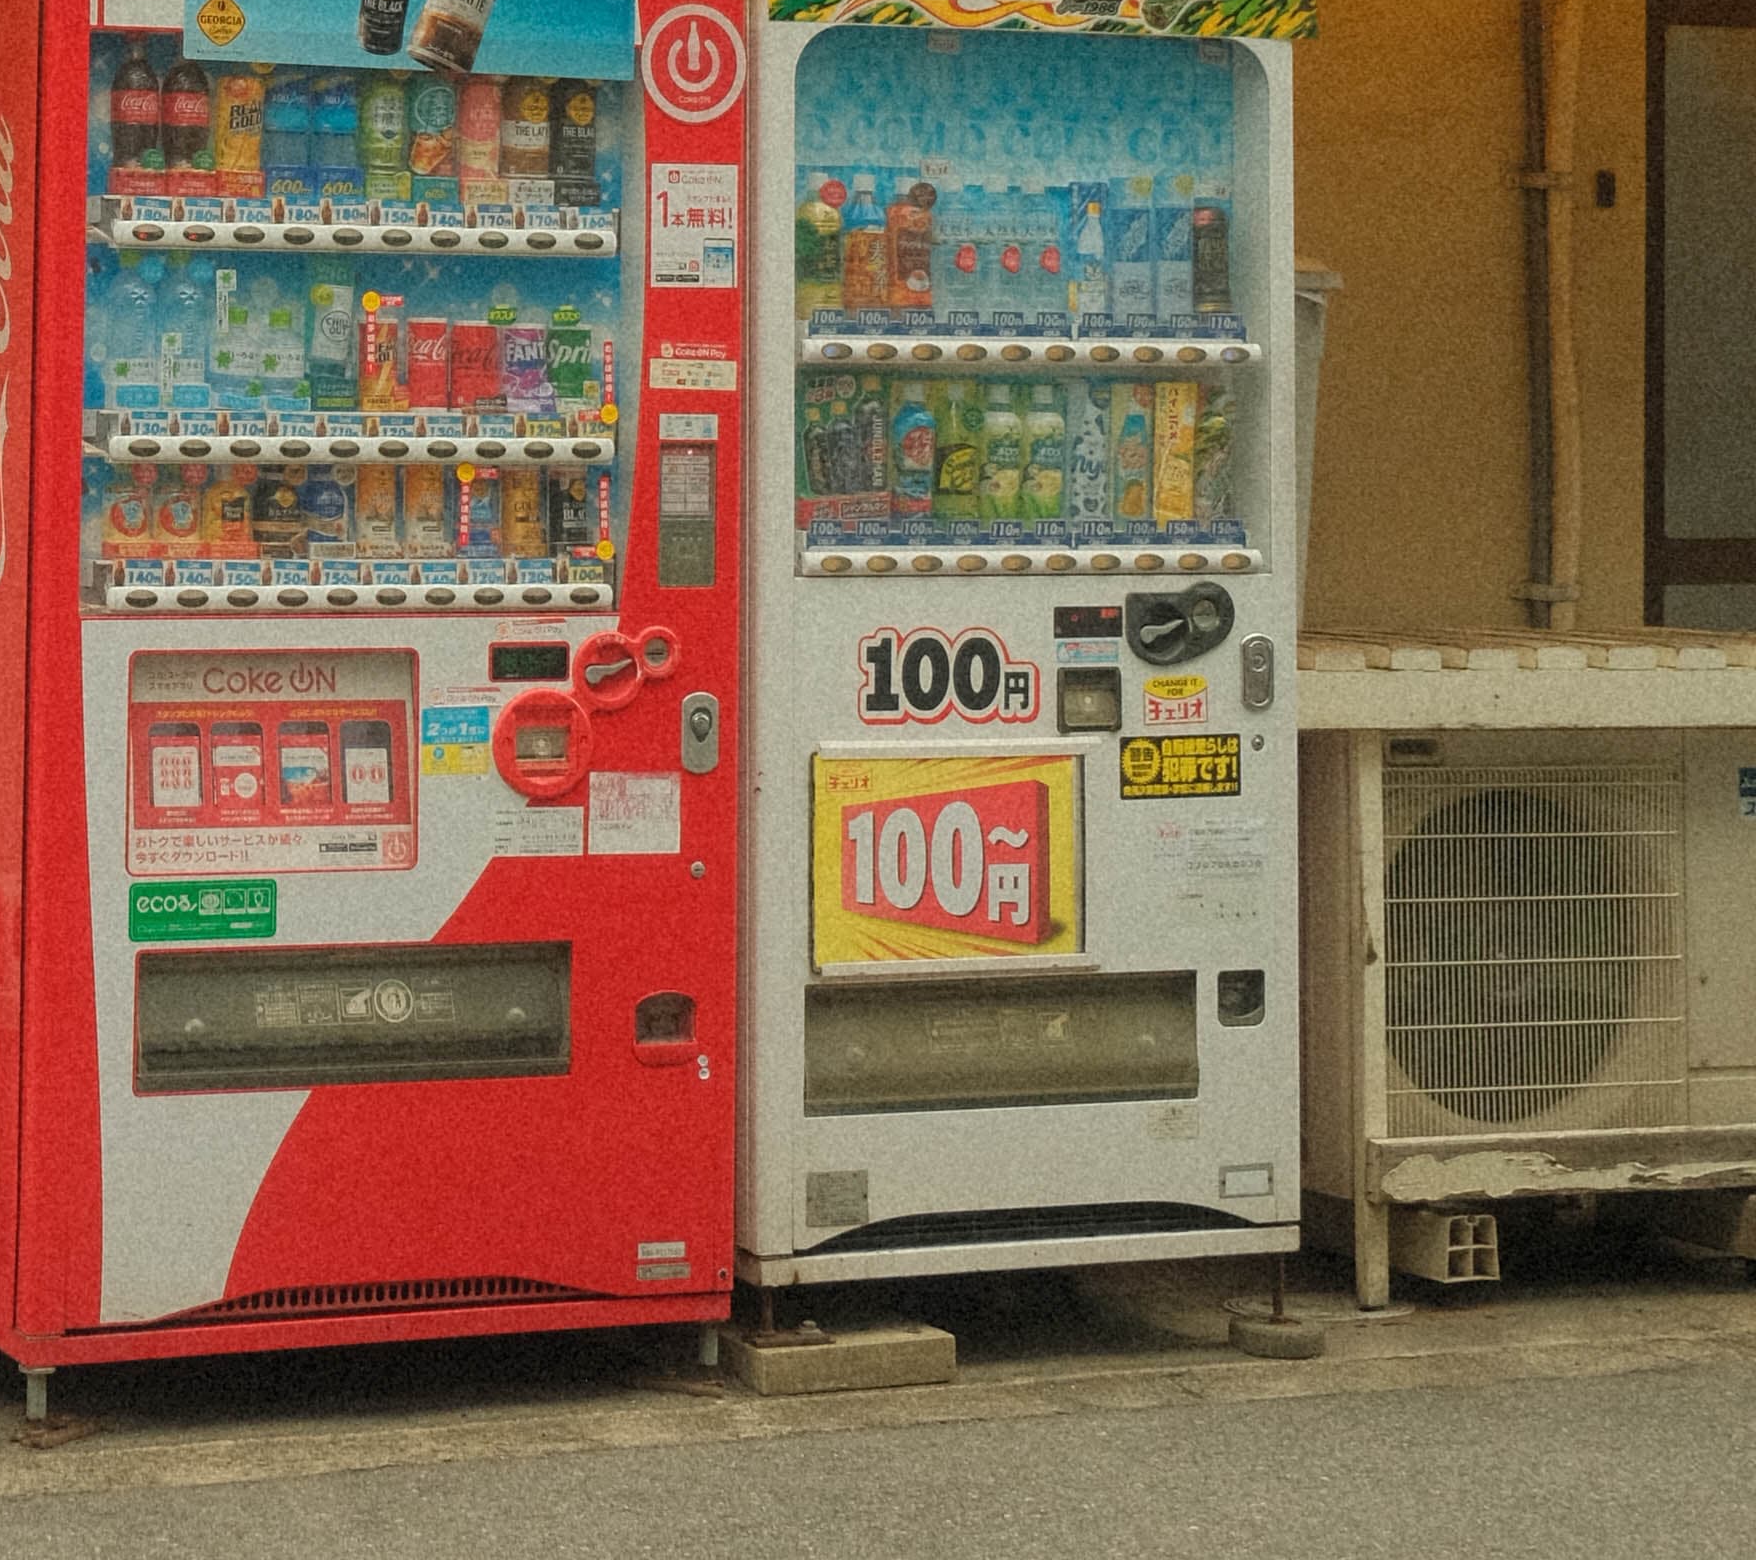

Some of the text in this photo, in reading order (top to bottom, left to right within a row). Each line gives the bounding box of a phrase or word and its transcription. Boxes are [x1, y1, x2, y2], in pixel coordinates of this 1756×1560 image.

[200, 14, 242, 26] GEORGIA
[1084, 1, 1119, 15] 1986
[656, 190, 733, 230] 1本無料!
[506, 341, 544, 361] FANT
[548, 339, 592, 369] Spri
[202, 666, 283, 695] Coke
[864, 635, 1031, 713] 100円
[1148, 697, 1203, 721] チェリオ
